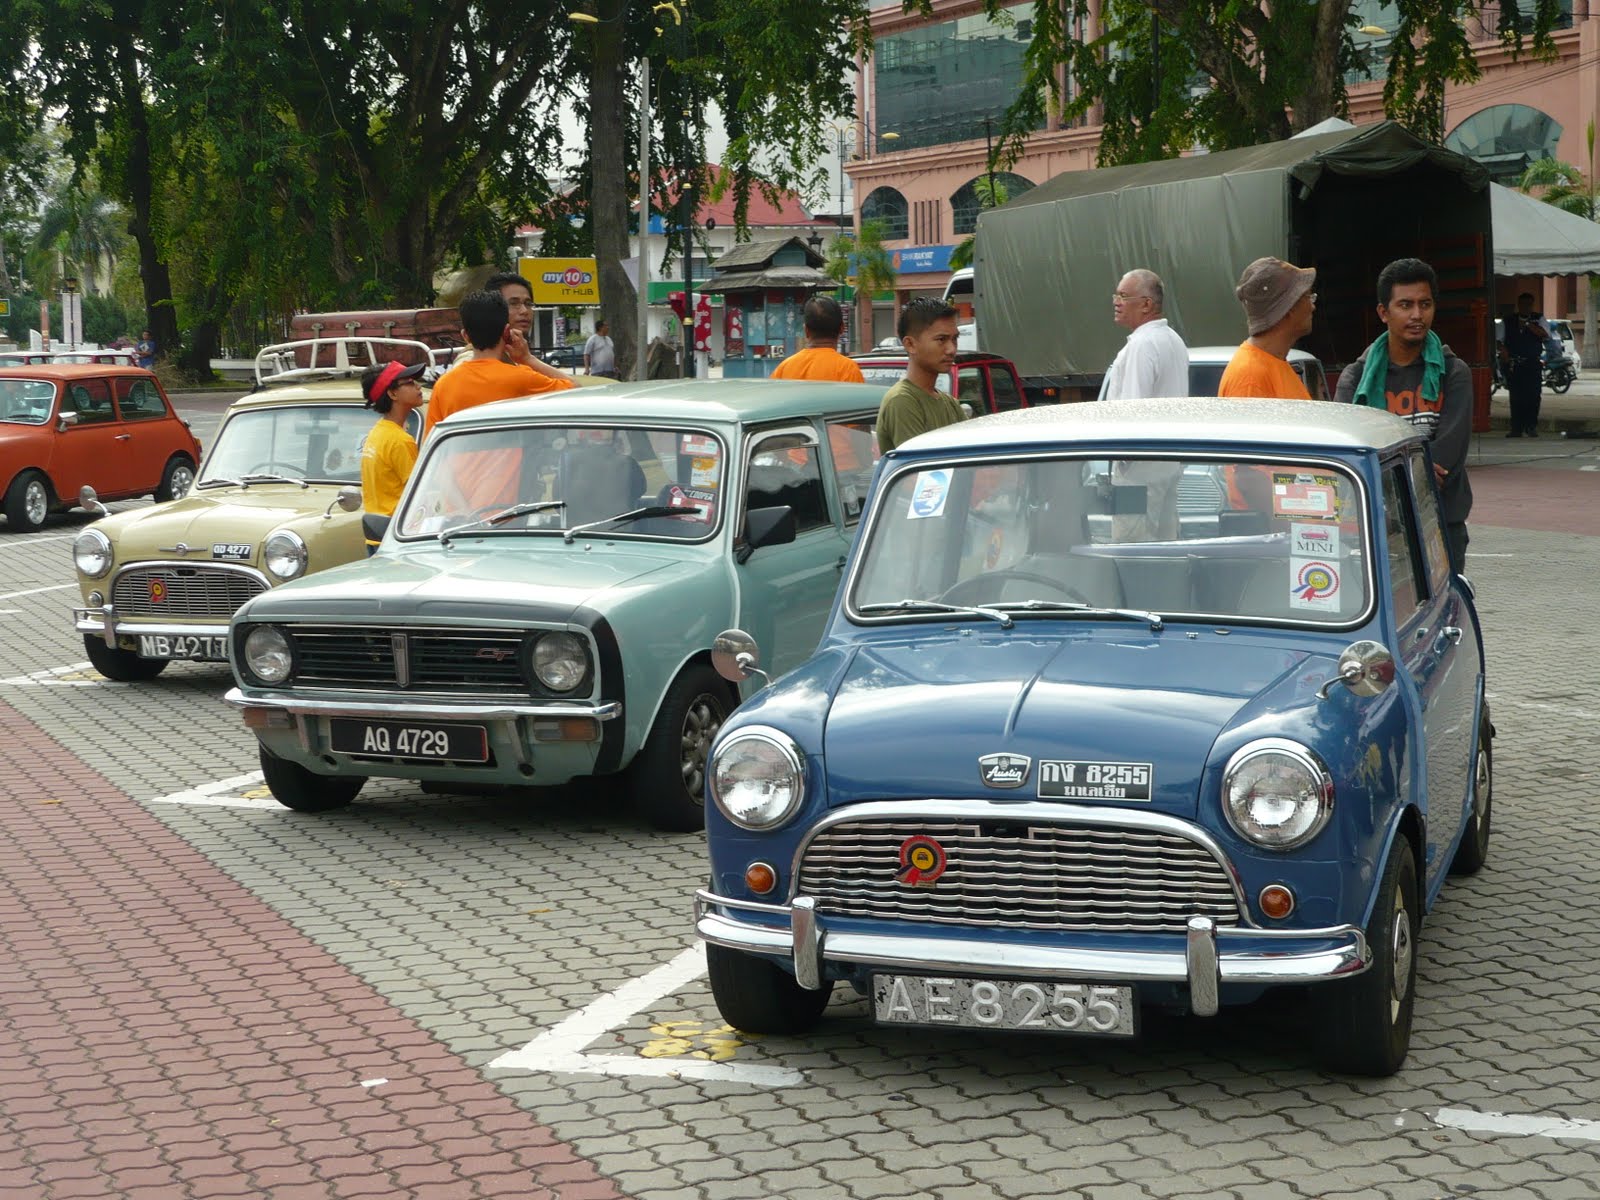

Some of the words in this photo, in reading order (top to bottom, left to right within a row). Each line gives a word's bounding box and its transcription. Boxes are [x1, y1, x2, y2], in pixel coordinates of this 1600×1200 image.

[562, 288, 571, 296] IT
[573, 288, 594, 296] HUB
[226, 545, 250, 555] 4277
[1297, 541, 1334, 554] MINI
[363, 726, 391, 752] AQ
[396, 728, 449, 755] 4729
[986, 765, 1023, 782] Austin
[1086, 764, 1148, 785] 8255
